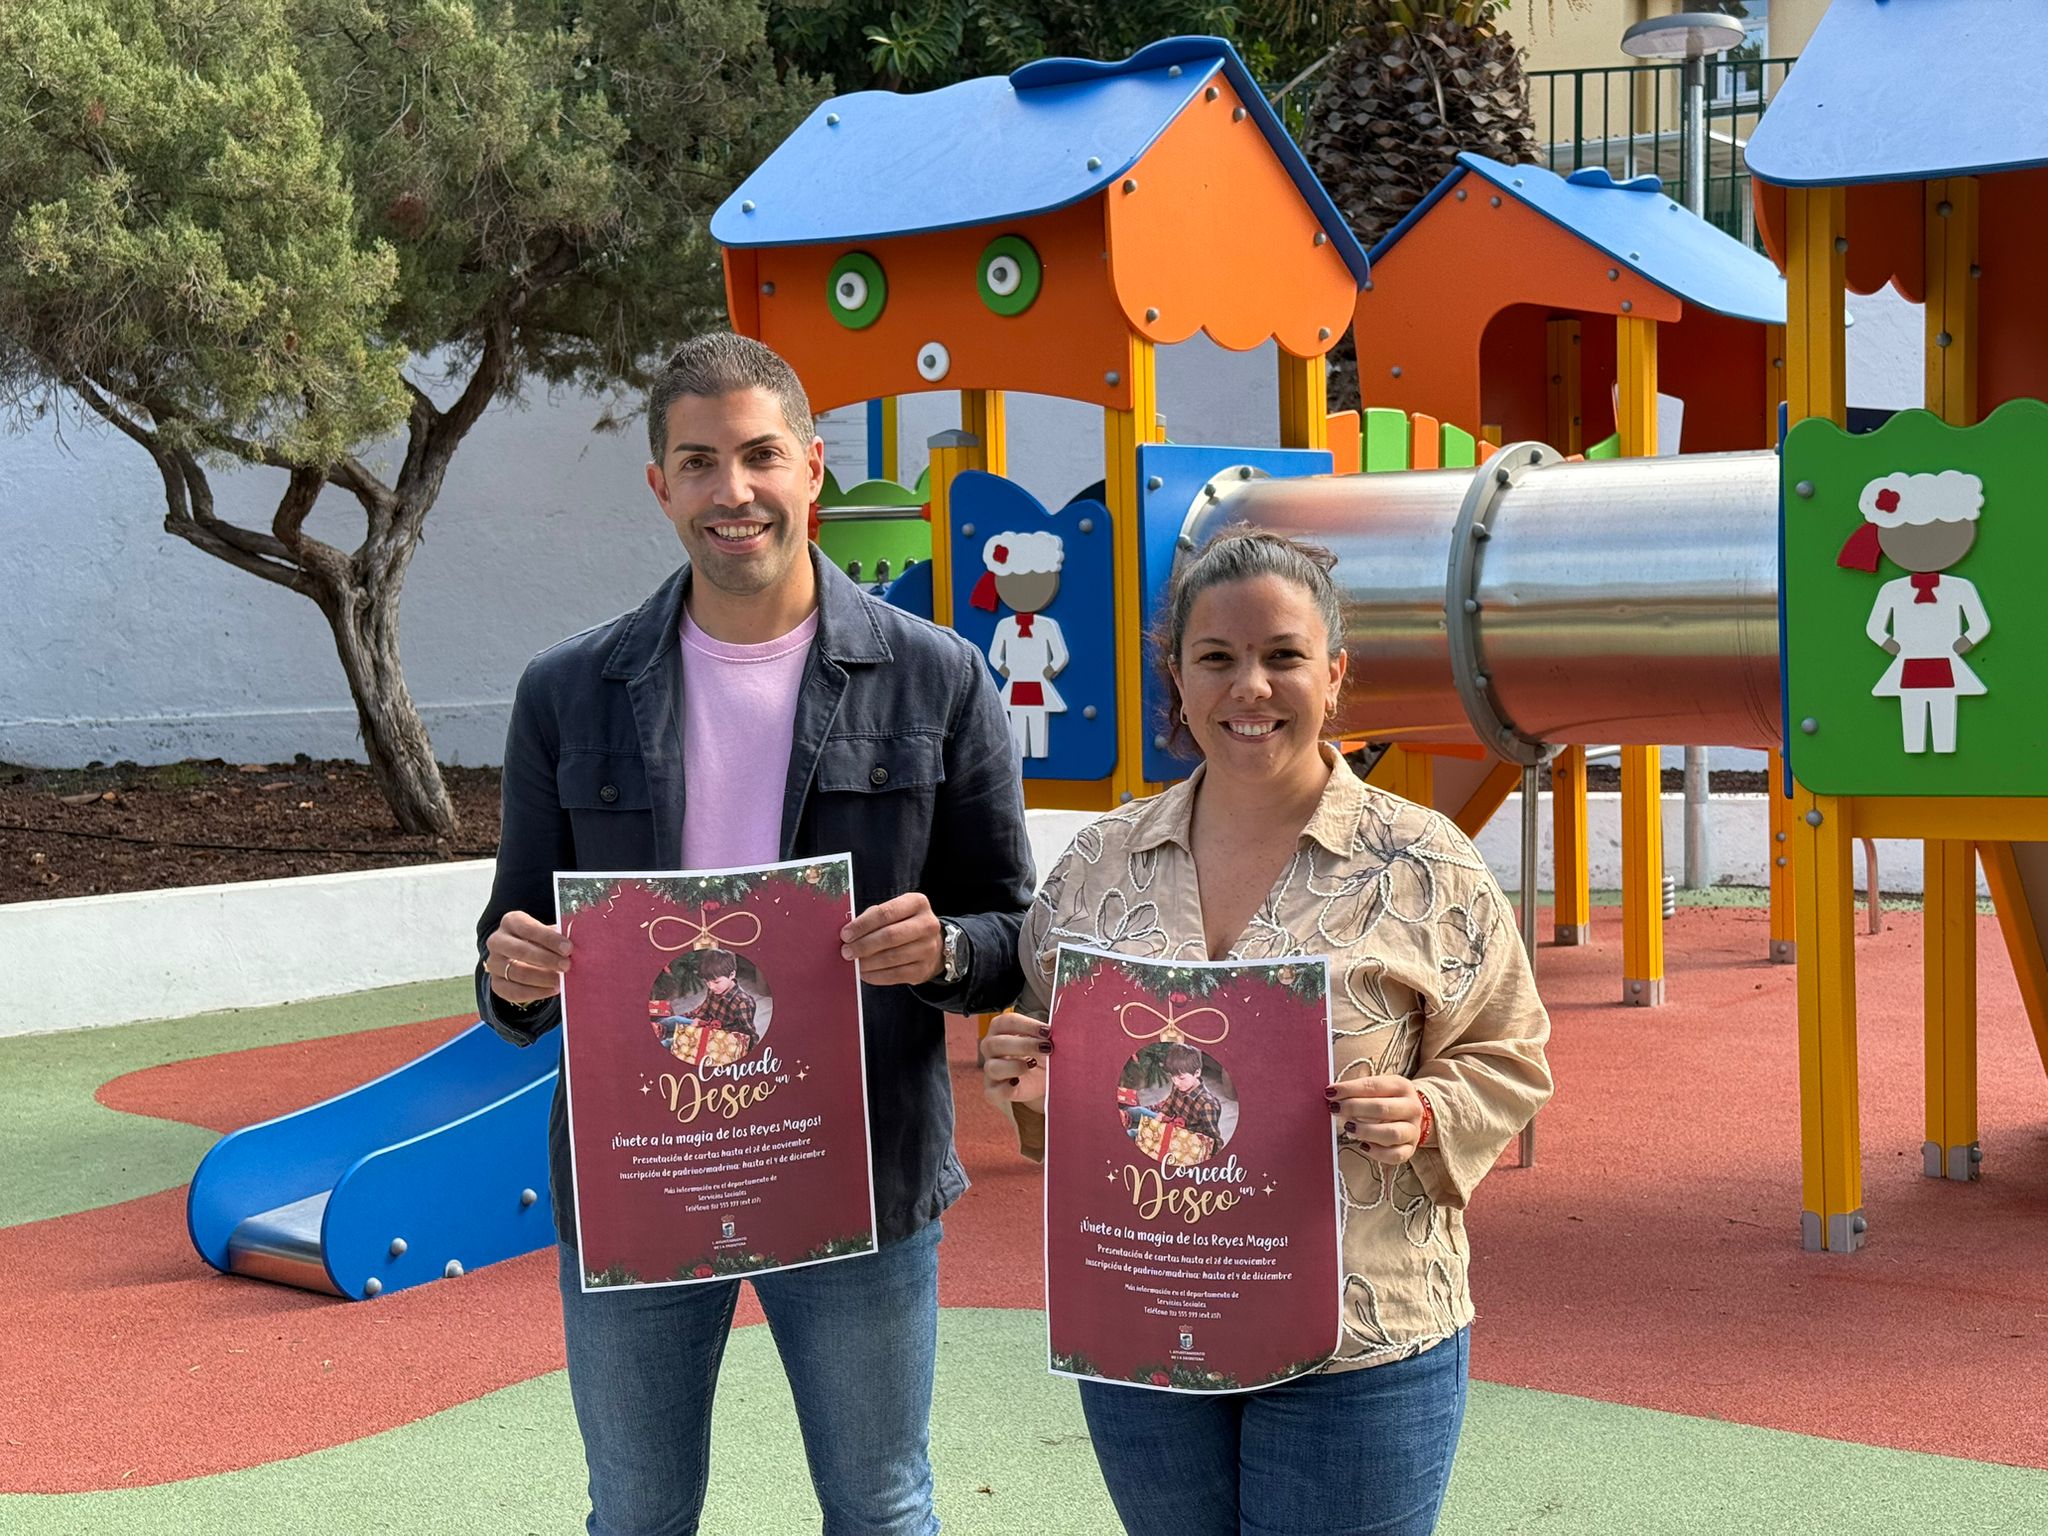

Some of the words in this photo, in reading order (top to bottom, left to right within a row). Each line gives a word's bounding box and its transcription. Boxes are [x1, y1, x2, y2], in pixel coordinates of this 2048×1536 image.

[698, 1046, 782, 1082] Concede
[775, 1073, 791, 1084] un
[659, 1072, 777, 1123] Deseo
[612, 1132, 648, 1150] ¡Únete
[650, 1136, 658, 1146] a
[661, 1133, 673, 1146] la
[676, 1130, 714, 1148] magia
[716, 1128, 730, 1140] de
[732, 1126, 748, 1139] los
[750, 1123, 781, 1136] Reyes
[782, 1115, 822, 1133] Magos!
[620, 1169, 661, 1180] Inscripción
[662, 1168, 672, 1177] de
[742, 1158, 764, 1169] hasta
[766, 1156, 773, 1165] el
[779, 1154, 788, 1163] de
[789, 1148, 826, 1161] diciembre
[632, 1153, 682, 1164] Presentación
[684, 1152, 693, 1161] de
[694, 1150, 720, 1160] cartas
[721, 1147, 744, 1158] hasta
[744, 1146, 752, 1154] el
[762, 1143, 771, 1152] de
[772, 1137, 811, 1150] noviembre
[1160, 1152, 1247, 1185] Concede
[1124, 1164, 1240, 1224] Deseo
[1239, 1186, 1256, 1196] un
[1080, 1216, 1112, 1236] ¡Únete
[1114, 1228, 1122, 1238] a
[1124, 1226, 1135, 1240] la
[1137, 1231, 1174, 1248] magia
[1176, 1231, 1190, 1245] de
[1193, 1233, 1209, 1246] los
[1211, 1234, 1244, 1248] Reyes
[1246, 1234, 1288, 1252] Magos!
[1085, 1258, 1122, 1271] Inscripción
[1123, 1263, 1132, 1272] de
[1202, 1270, 1226, 1280] hasta
[1226, 1272, 1235, 1280] el
[1242, 1272, 1252, 1280] de
[1252, 1272, 1294, 1280] diciembre
[1097, 1243, 1143, 1260] Presentación
[1144, 1250, 1154, 1260] de
[1154, 1254, 1180, 1263] cartas
[1181, 1255, 1204, 1265] hasta
[1205, 1256, 1213, 1264] el
[1222, 1256, 1233, 1266] de
[1234, 1257, 1277, 1266] noviembre
